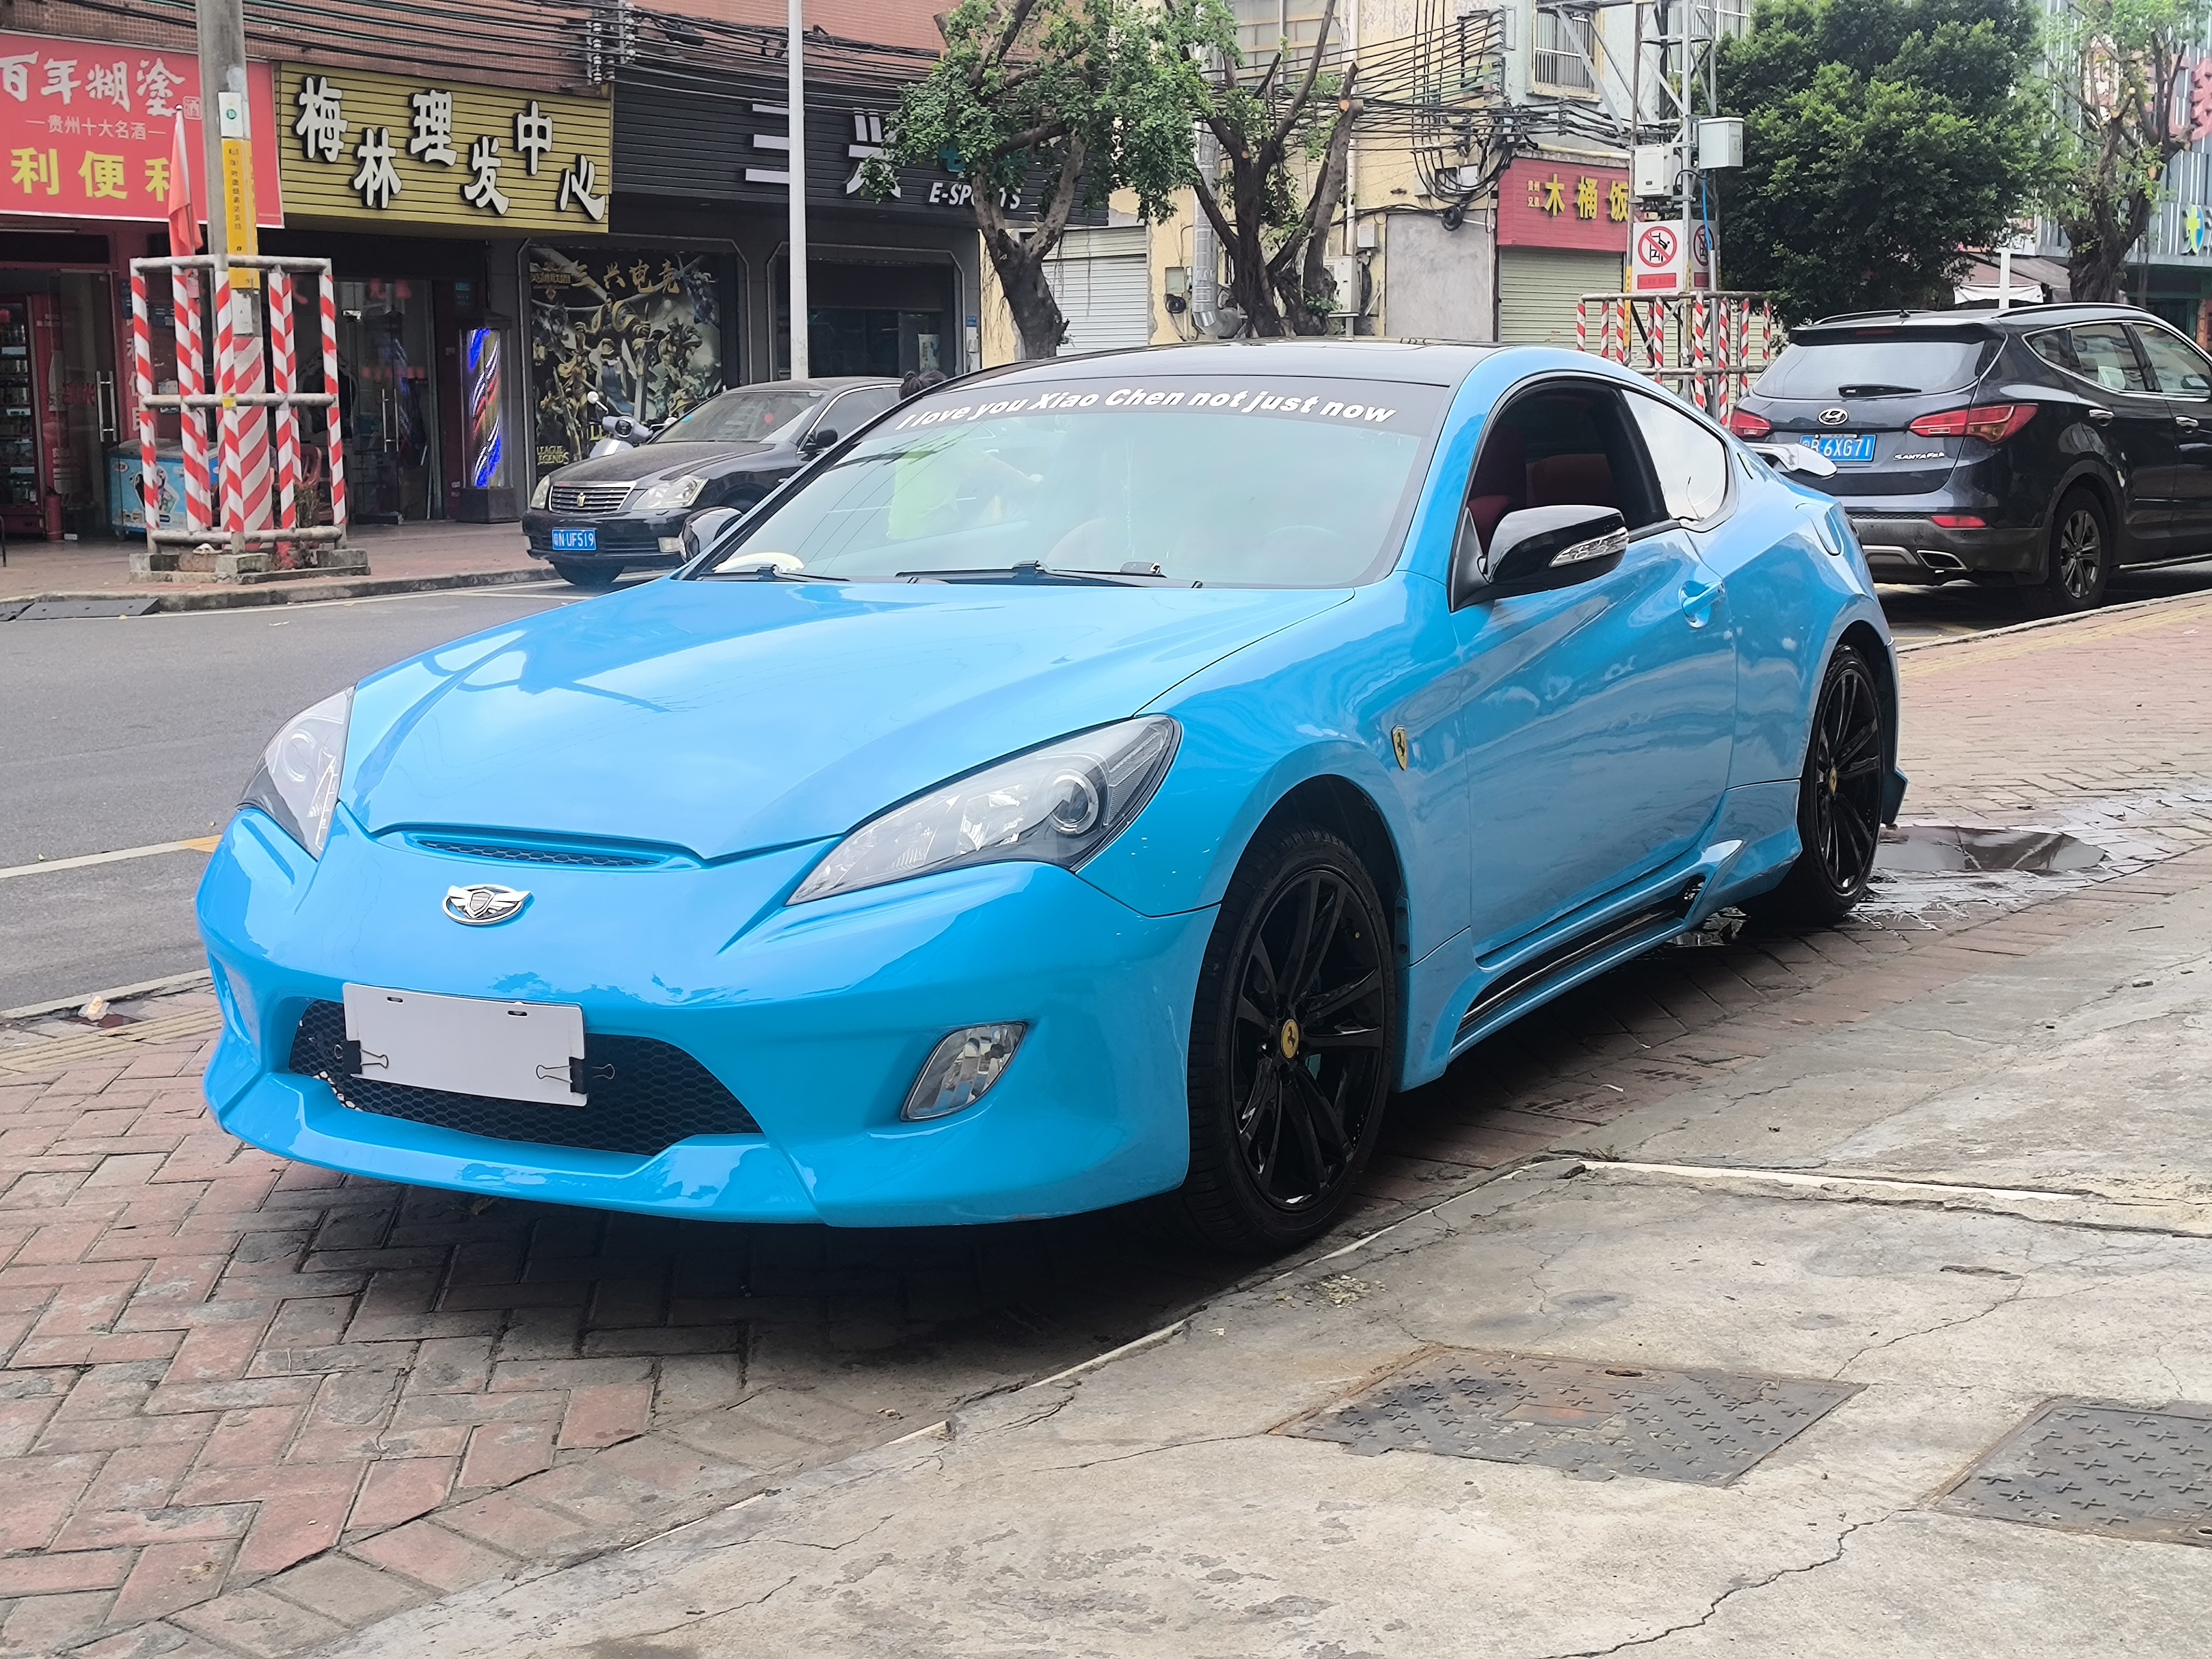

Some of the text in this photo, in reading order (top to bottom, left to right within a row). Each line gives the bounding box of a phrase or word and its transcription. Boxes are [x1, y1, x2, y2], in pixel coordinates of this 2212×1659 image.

[48, 114, 146, 140] 贵州十大名酒
[295, 76, 606, 221] 梅林理发中心
[928, 181, 1021, 210] E-SPTS
[1544, 173, 1629, 222] 木桶饭
[894, 388, 1397, 431] I love you Xiao Chen not just now
